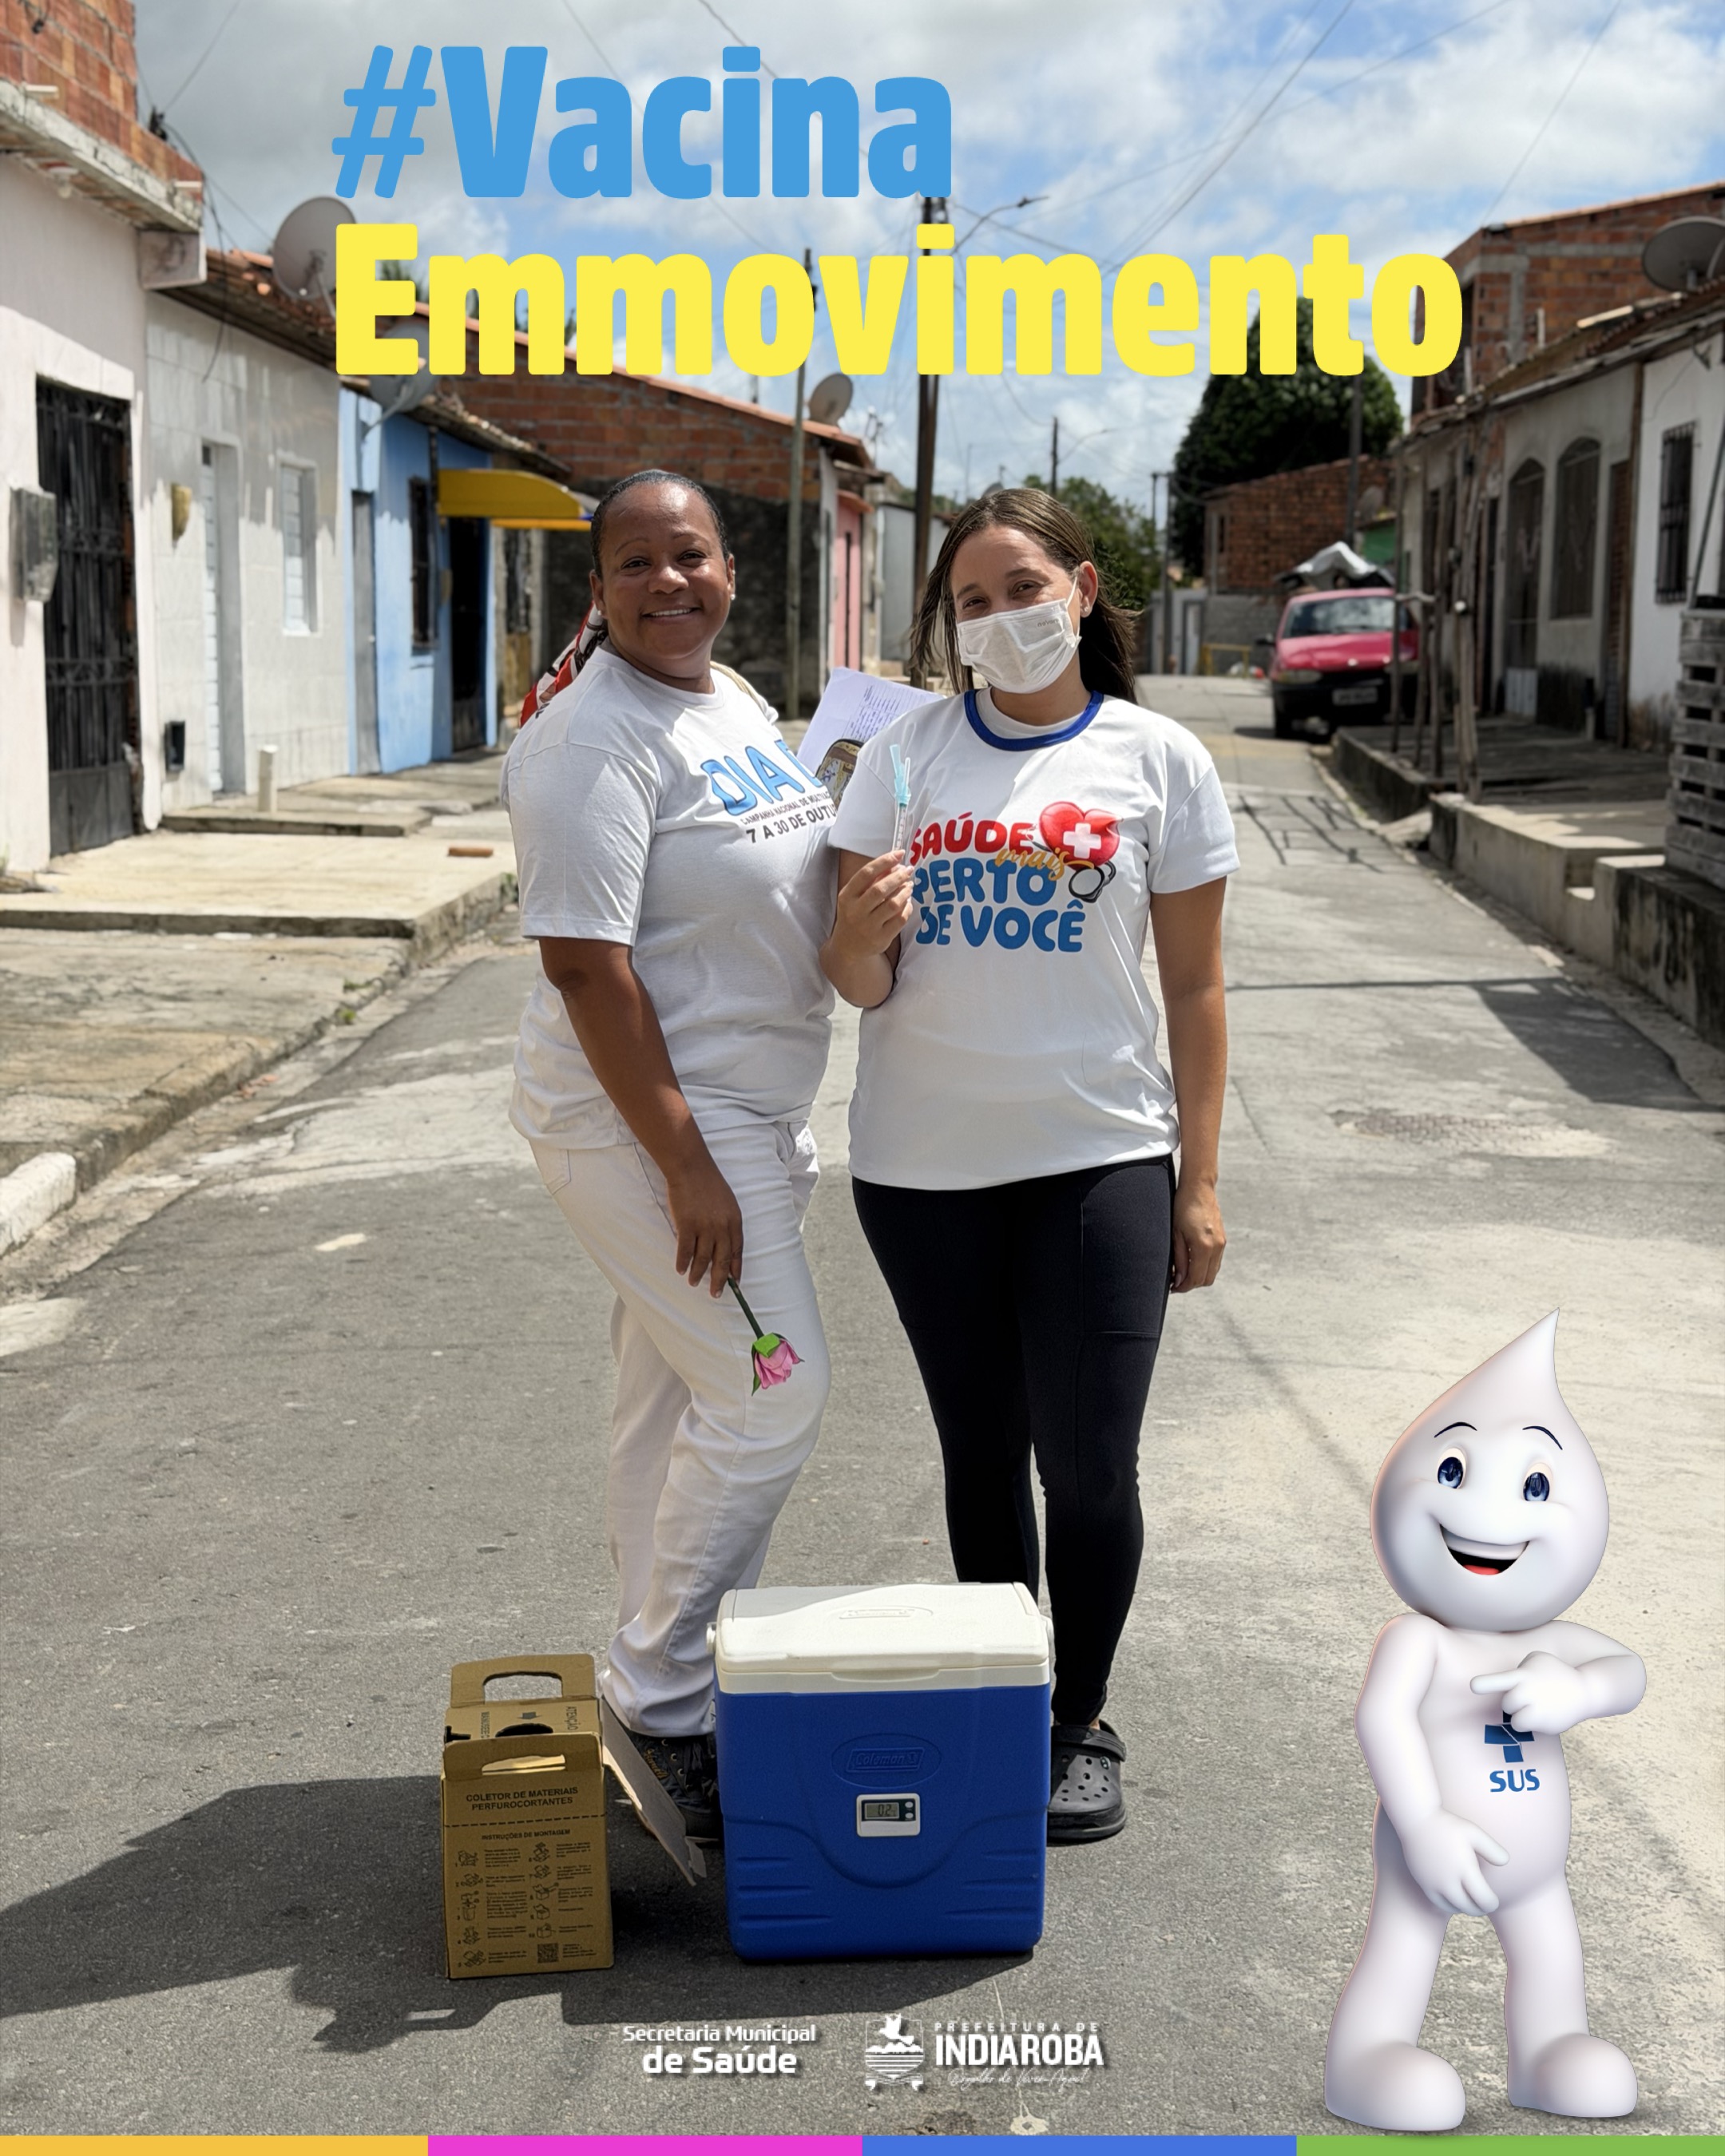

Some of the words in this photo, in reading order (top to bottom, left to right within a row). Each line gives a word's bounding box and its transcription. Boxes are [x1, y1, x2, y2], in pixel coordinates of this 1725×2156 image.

[700, 745, 806, 816] DIA
[740, 810, 774, 825] CAMPANHA
[773, 801, 801, 815] NACIONAL
[799, 797, 810, 807] DE
[746, 828, 756, 843] 7
[763, 825, 775, 839] A
[774, 819, 789, 835] 30
[788, 813, 807, 830] DE
[910, 811, 1036, 866] SAÚDE
[994, 847, 1094, 882] mais
[912, 858, 1057, 906] PERTO
[916, 904, 954, 945] DE
[960, 899, 1086, 953] VOCÊ
[855, 1753, 905, 1766] Coleman
[466, 1793, 511, 1801] COLETOR
[529, 1787, 578, 1798] MATERIAIS
[472, 1797, 573, 1810] PERFUROCORTANTES
[482, 1832, 521, 1841] INSTRUÇÕES
